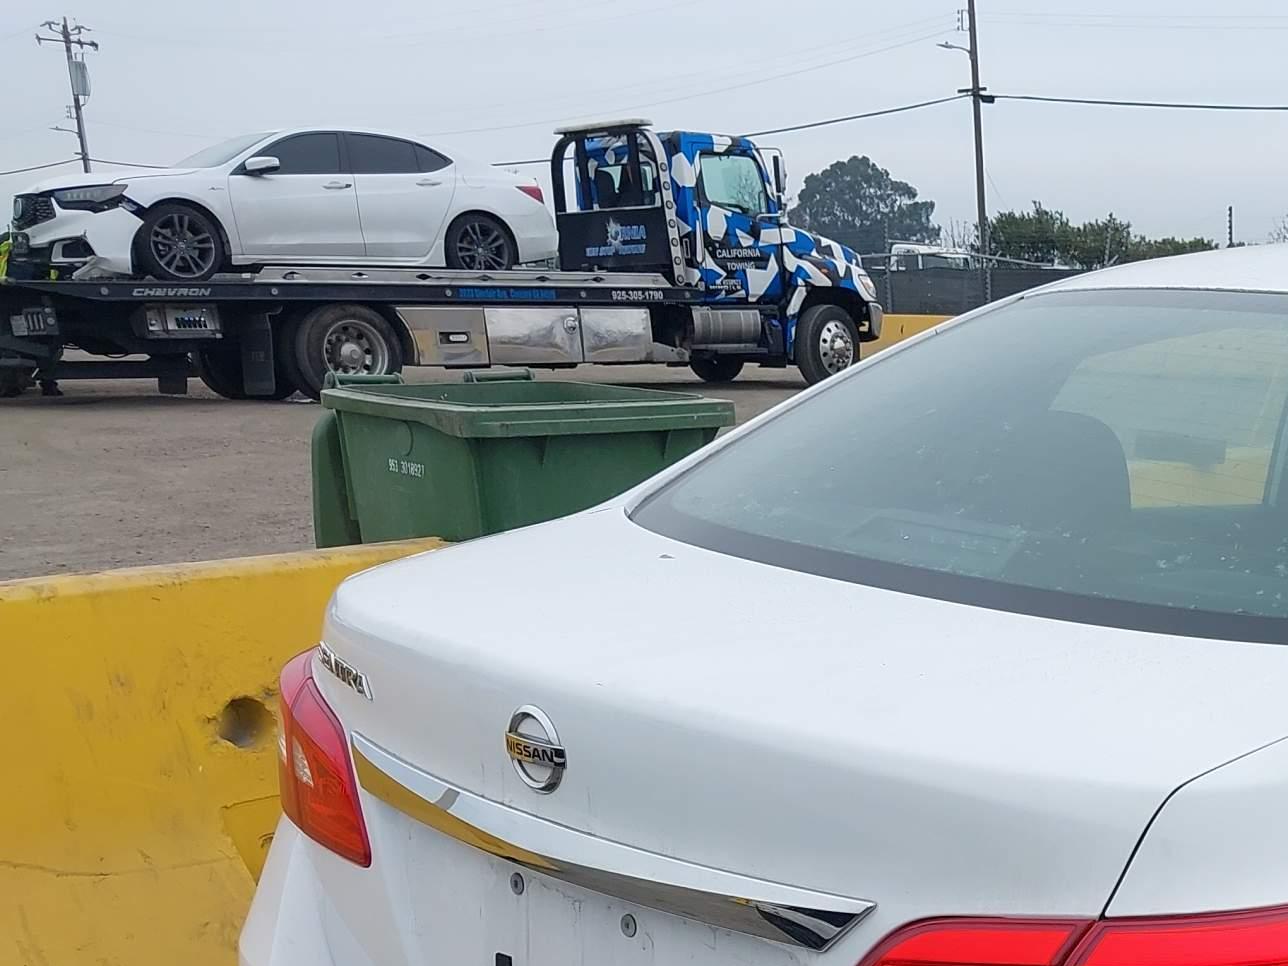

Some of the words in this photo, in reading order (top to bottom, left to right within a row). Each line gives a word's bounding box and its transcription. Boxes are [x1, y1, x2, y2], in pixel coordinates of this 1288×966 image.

[716, 248, 760, 258] CALIFORNIA
[727, 261, 756, 270] TOWING
[132, 288, 211, 296] CHEVRON
[611, 290, 664, 300] 925-305-1790
[319, 640, 373, 701] SENTRA
[506, 738, 554, 763] NISSAN
